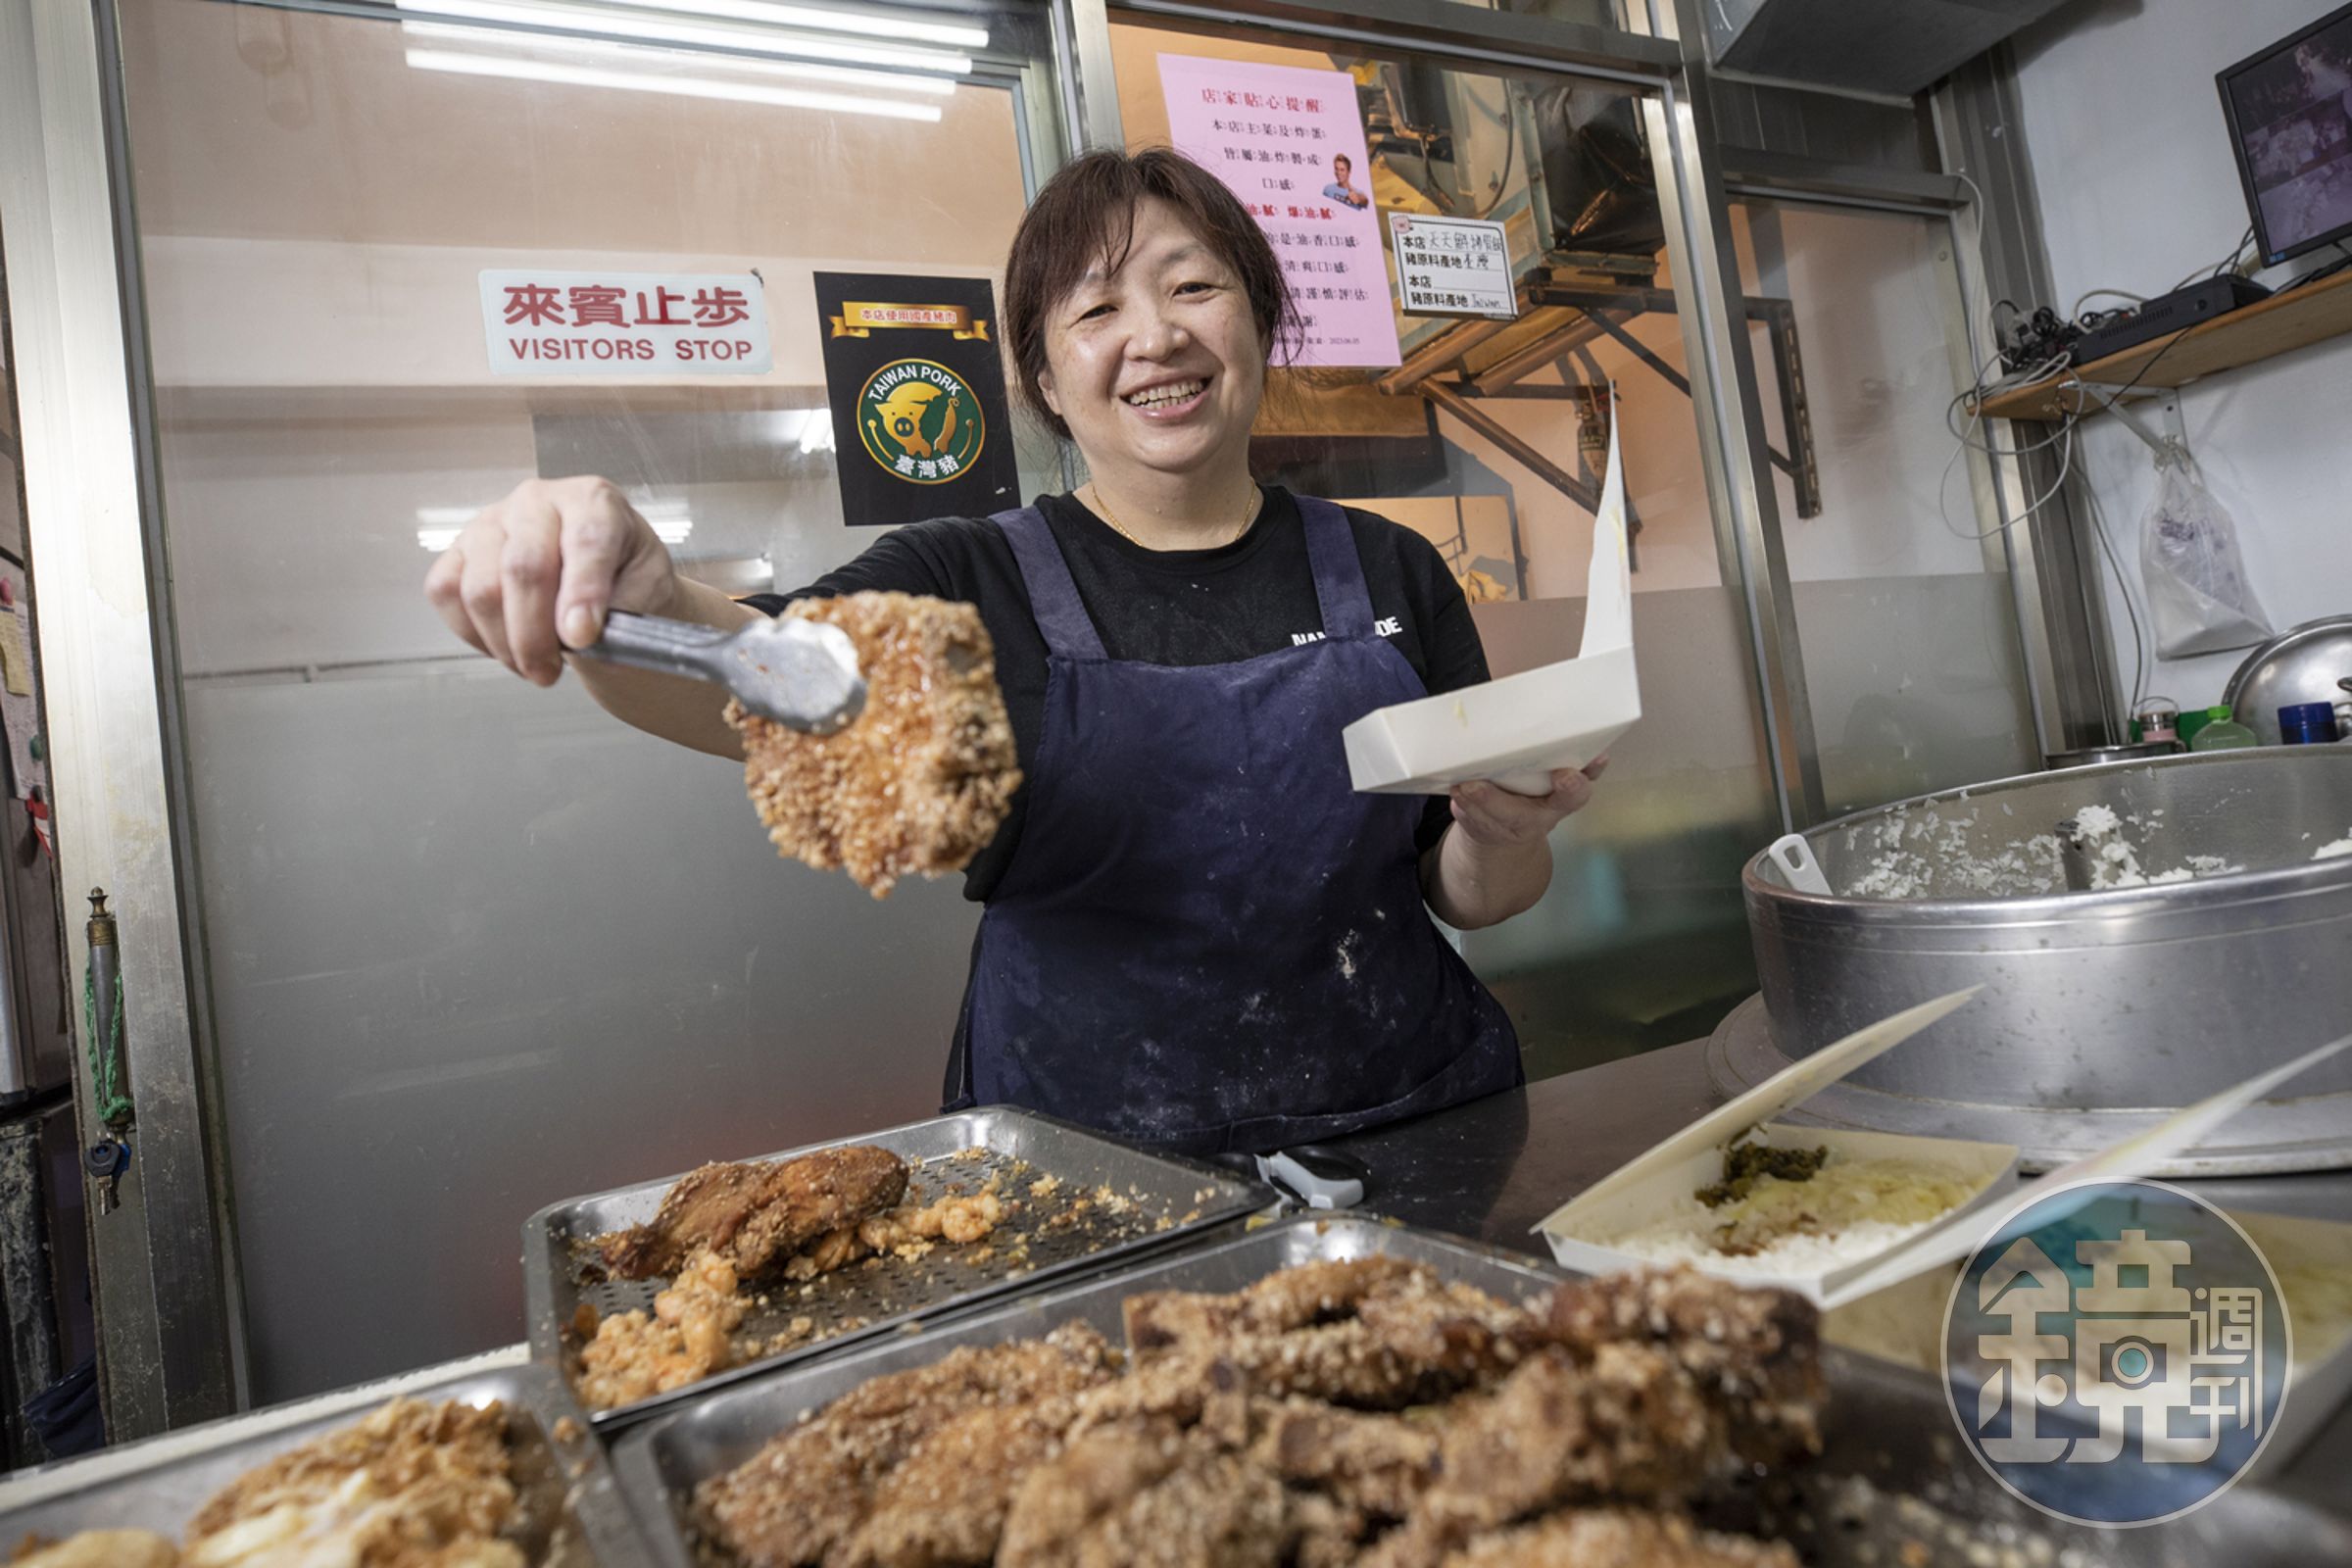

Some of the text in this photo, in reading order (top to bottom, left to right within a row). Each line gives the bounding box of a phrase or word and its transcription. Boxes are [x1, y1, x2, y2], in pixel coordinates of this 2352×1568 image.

[1201, 88, 1324, 113] 店家貼心提醒
[1402, 235, 1426, 250] 本店
[1408, 274, 1432, 289] 本店
[1410, 292, 1468, 307] 豬原料產地
[509, 338, 753, 361] VISITORS STOP
[868, 365, 961, 401] TAIWAN PORK
[894, 454, 959, 478] 臺灣豬
